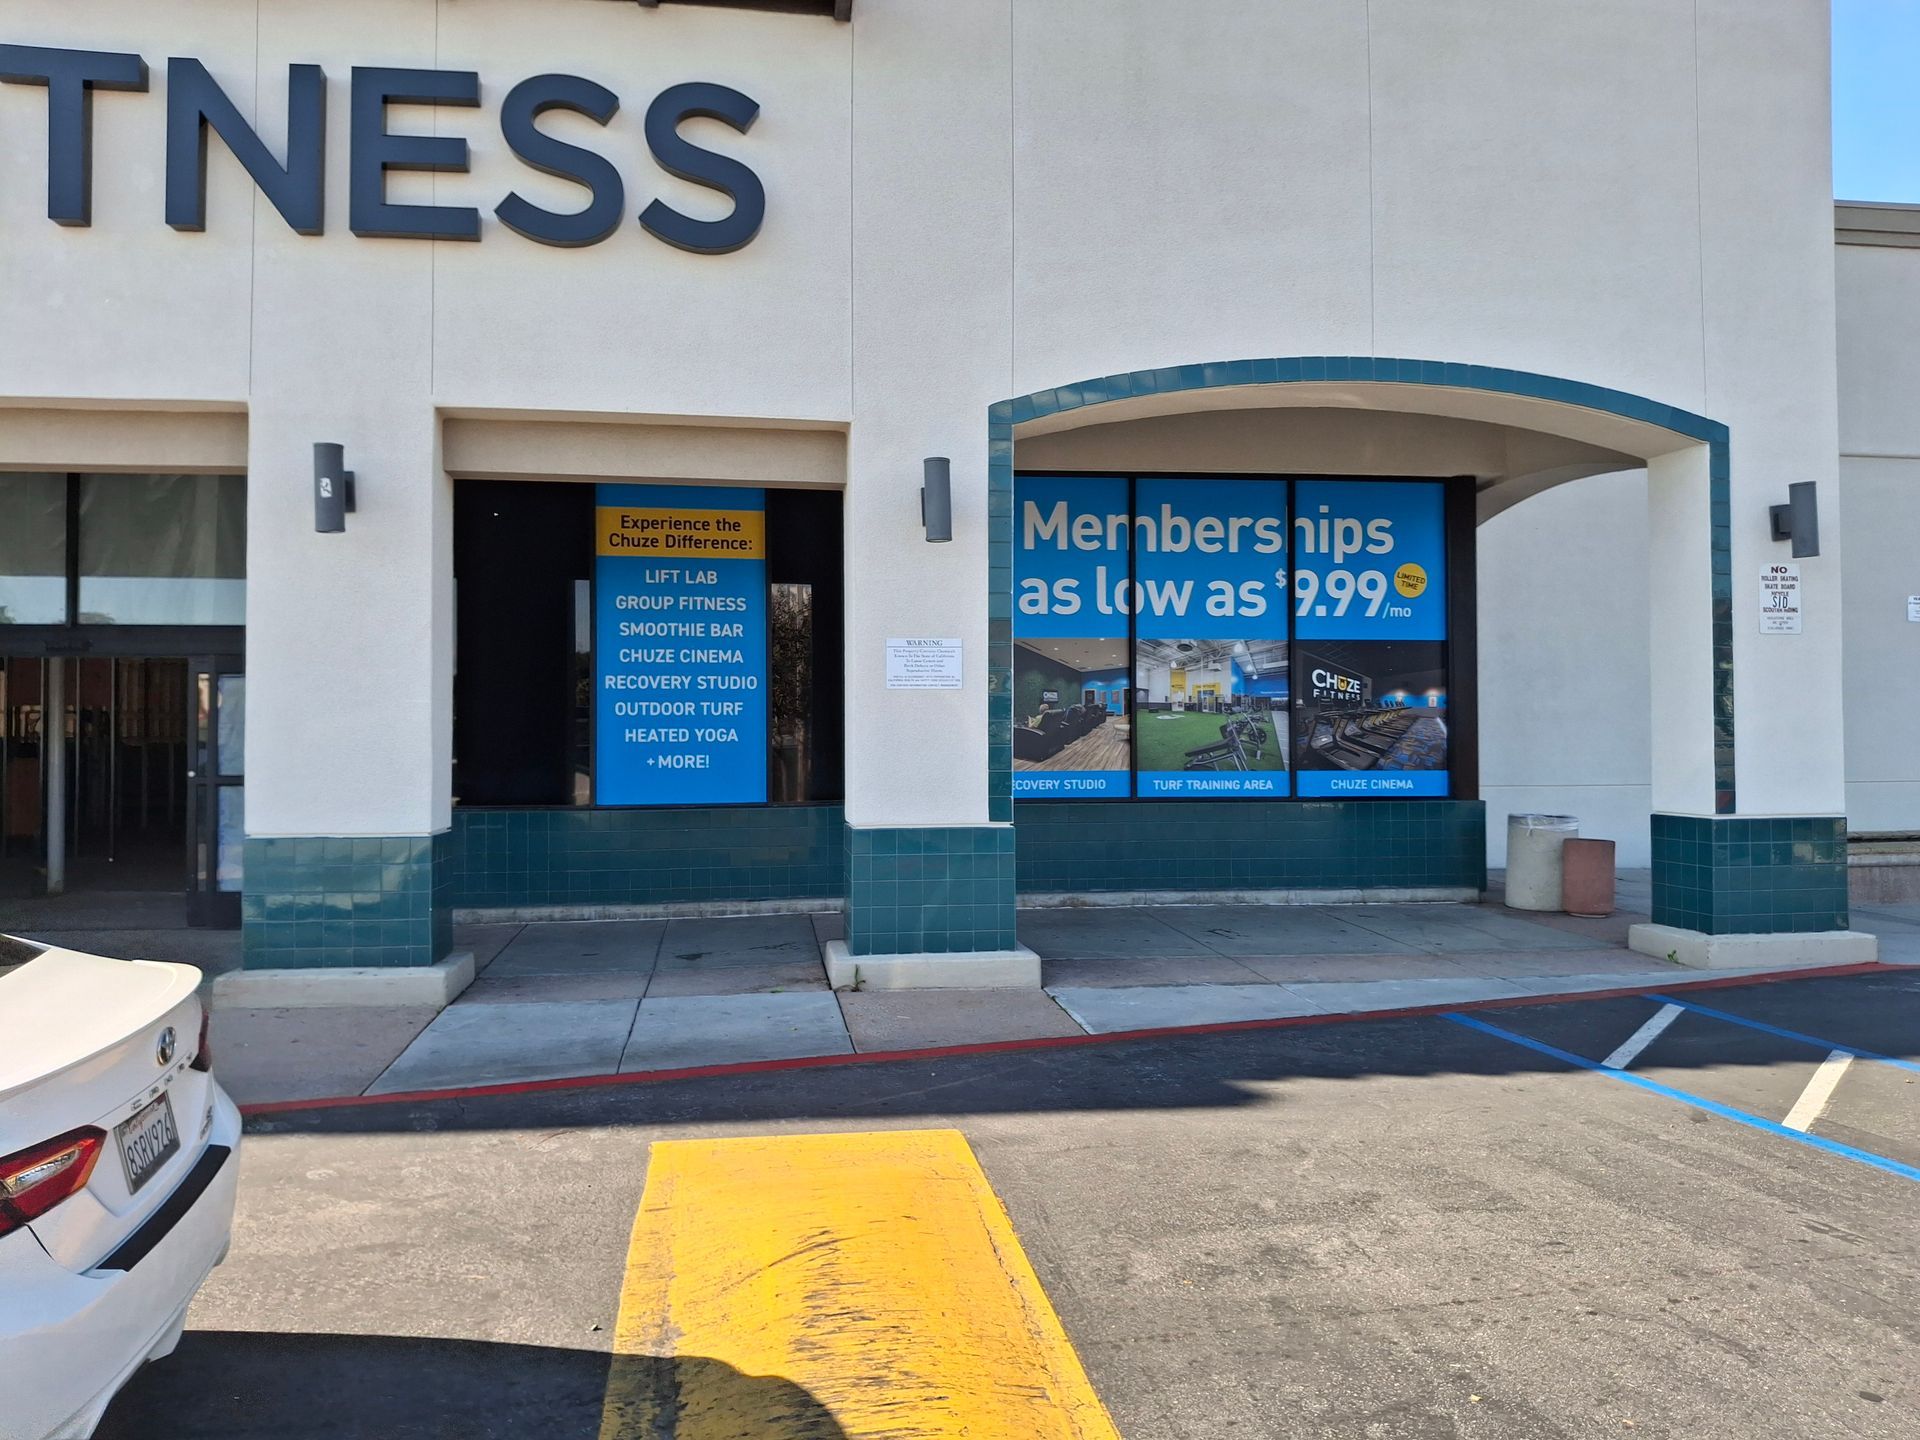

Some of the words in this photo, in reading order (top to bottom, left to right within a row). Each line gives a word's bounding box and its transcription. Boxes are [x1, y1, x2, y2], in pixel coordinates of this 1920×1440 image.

[0, 44, 765, 255] TNESS
[620, 514, 711, 533] Experience
[716, 518, 741, 532] the
[1023, 500, 1395, 564] Memberships
[609, 533, 659, 548] Chuze
[665, 534, 753, 550] Difference:
[645, 569, 680, 583] LIFT
[685, 570, 718, 585] LAB
[1770, 565, 1788, 574] NO
[1396, 571, 1426, 585] LIMITED
[1401, 580, 1418, 591] TIME
[1018, 577, 1082, 616] as
[1096, 566, 1195, 617] low
[1205, 579, 1267, 618] as
[616, 595, 674, 610] GROUP
[679, 596, 747, 611] FITNESS
[619, 622, 705, 637] SMOOTHIE
[711, 623, 744, 638] BAR
[619, 649, 675, 663] CHUZE
[680, 649, 744, 664] CINEMA
[605, 675, 692, 690] RECOVERY
[697, 676, 758, 690] STUDIO
[1312, 669, 1361, 694] CHUZE
[1313, 688, 1361, 702] FITNESS
[615, 702, 696, 716] OUTDOOR
[700, 702, 744, 716] TURF
[625, 729, 689, 743] HEATED
[694, 729, 739, 743] YOGA
[1064, 779, 1107, 790] STUDIO
[1153, 779, 1183, 791] TURF
[1187, 779, 1240, 790] TRAINING
[1243, 779, 1274, 790] AREA
[1331, 779, 1368, 790] CHUZE
[1371, 779, 1414, 790] CINEMA
[126, 1112, 174, 1177] 8SRV926
